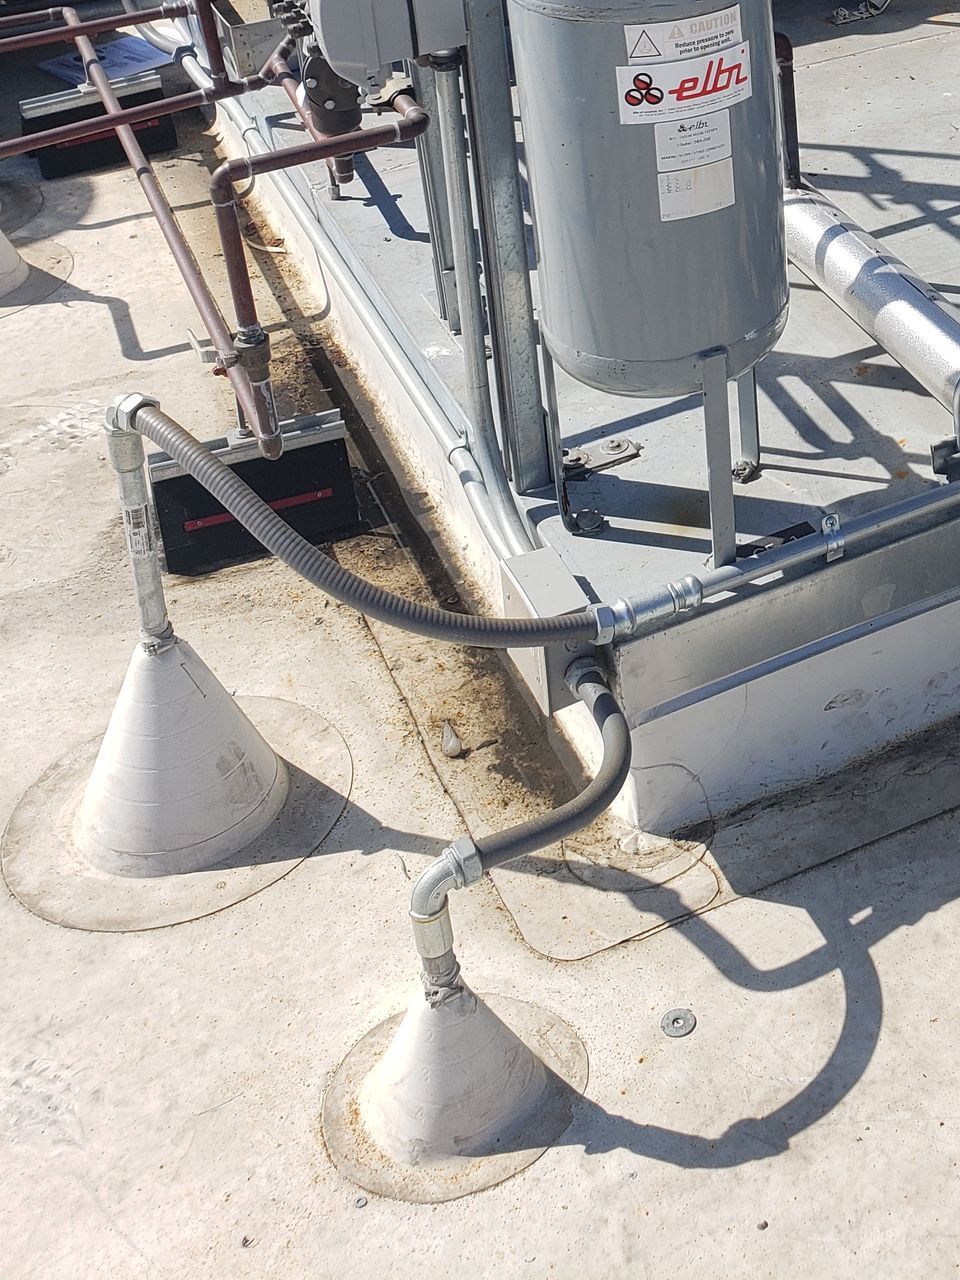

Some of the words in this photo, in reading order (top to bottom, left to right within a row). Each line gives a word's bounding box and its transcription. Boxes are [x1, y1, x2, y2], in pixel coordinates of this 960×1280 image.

[689, 11, 737, 34] CAUTION
[674, 40, 696, 49] Reduce
[696, 33, 719, 46] pressure
[719, 31, 725, 39] to
[725, 29, 735, 38] zero
[679, 47, 693, 56] prior
[700, 40, 721, 52] opening
[668, 48, 748, 102] elbi
